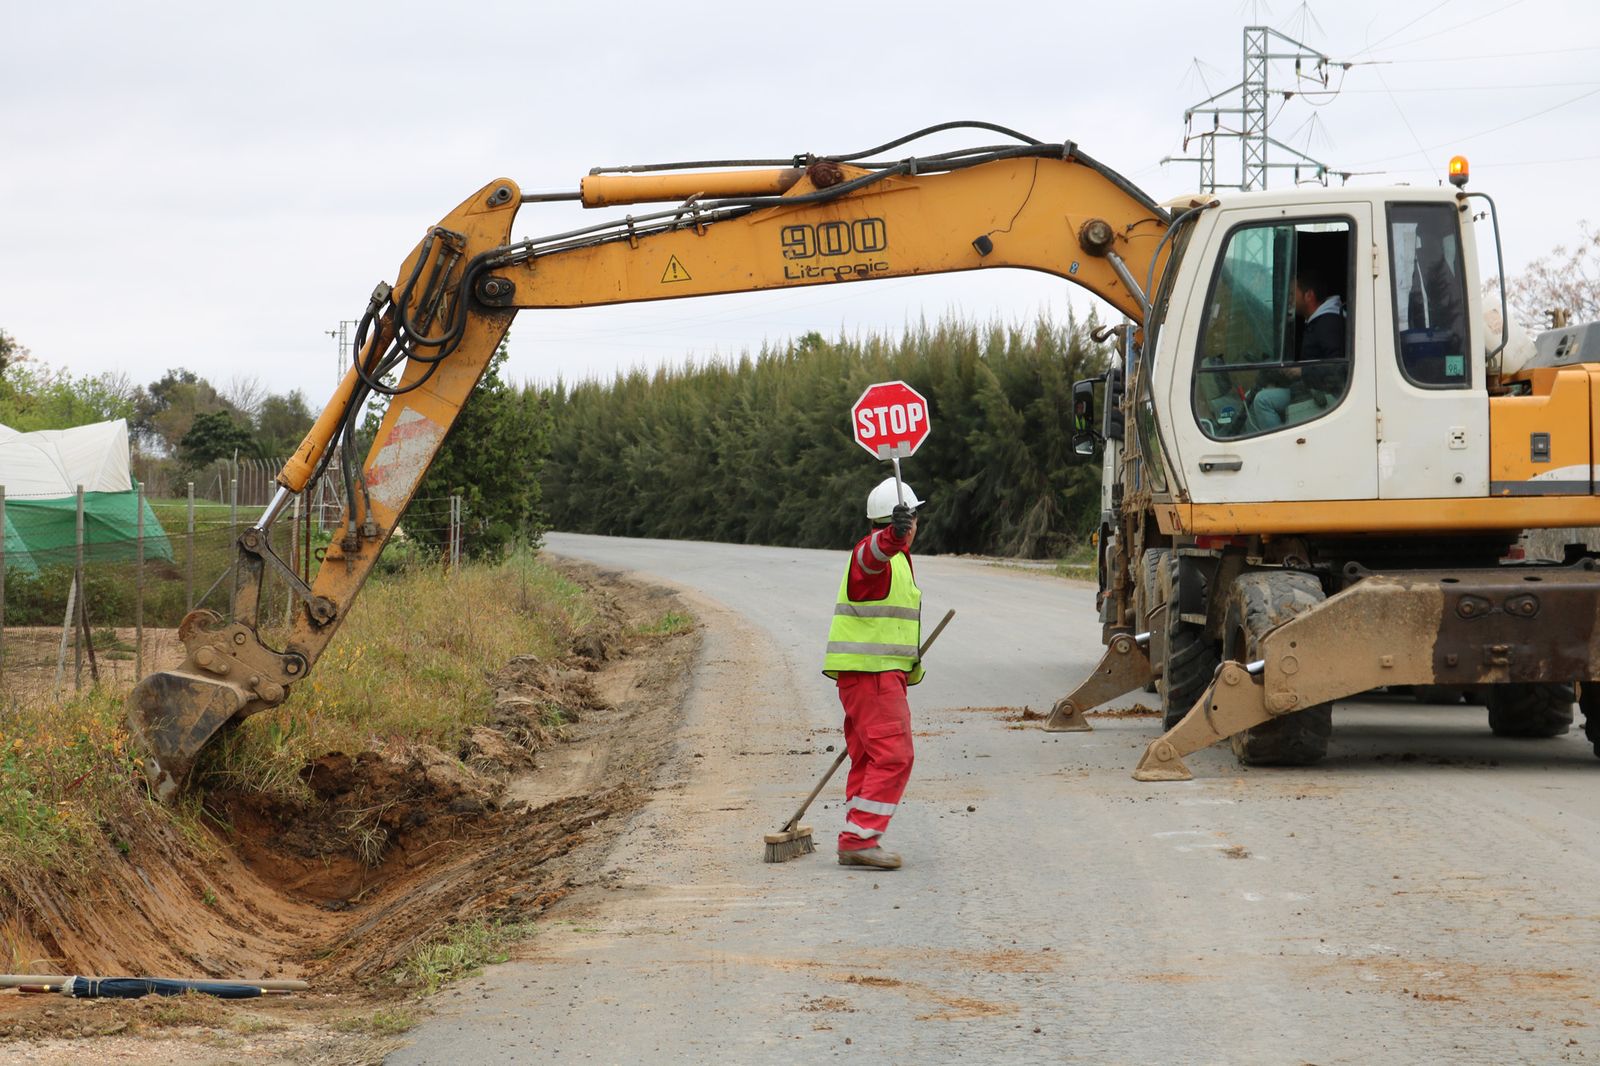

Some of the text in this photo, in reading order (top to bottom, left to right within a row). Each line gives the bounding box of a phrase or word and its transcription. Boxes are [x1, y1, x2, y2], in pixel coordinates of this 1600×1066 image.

[781, 217, 887, 260] 900
[784, 258, 889, 280] Litronic
[858, 402, 923, 438] STOP
